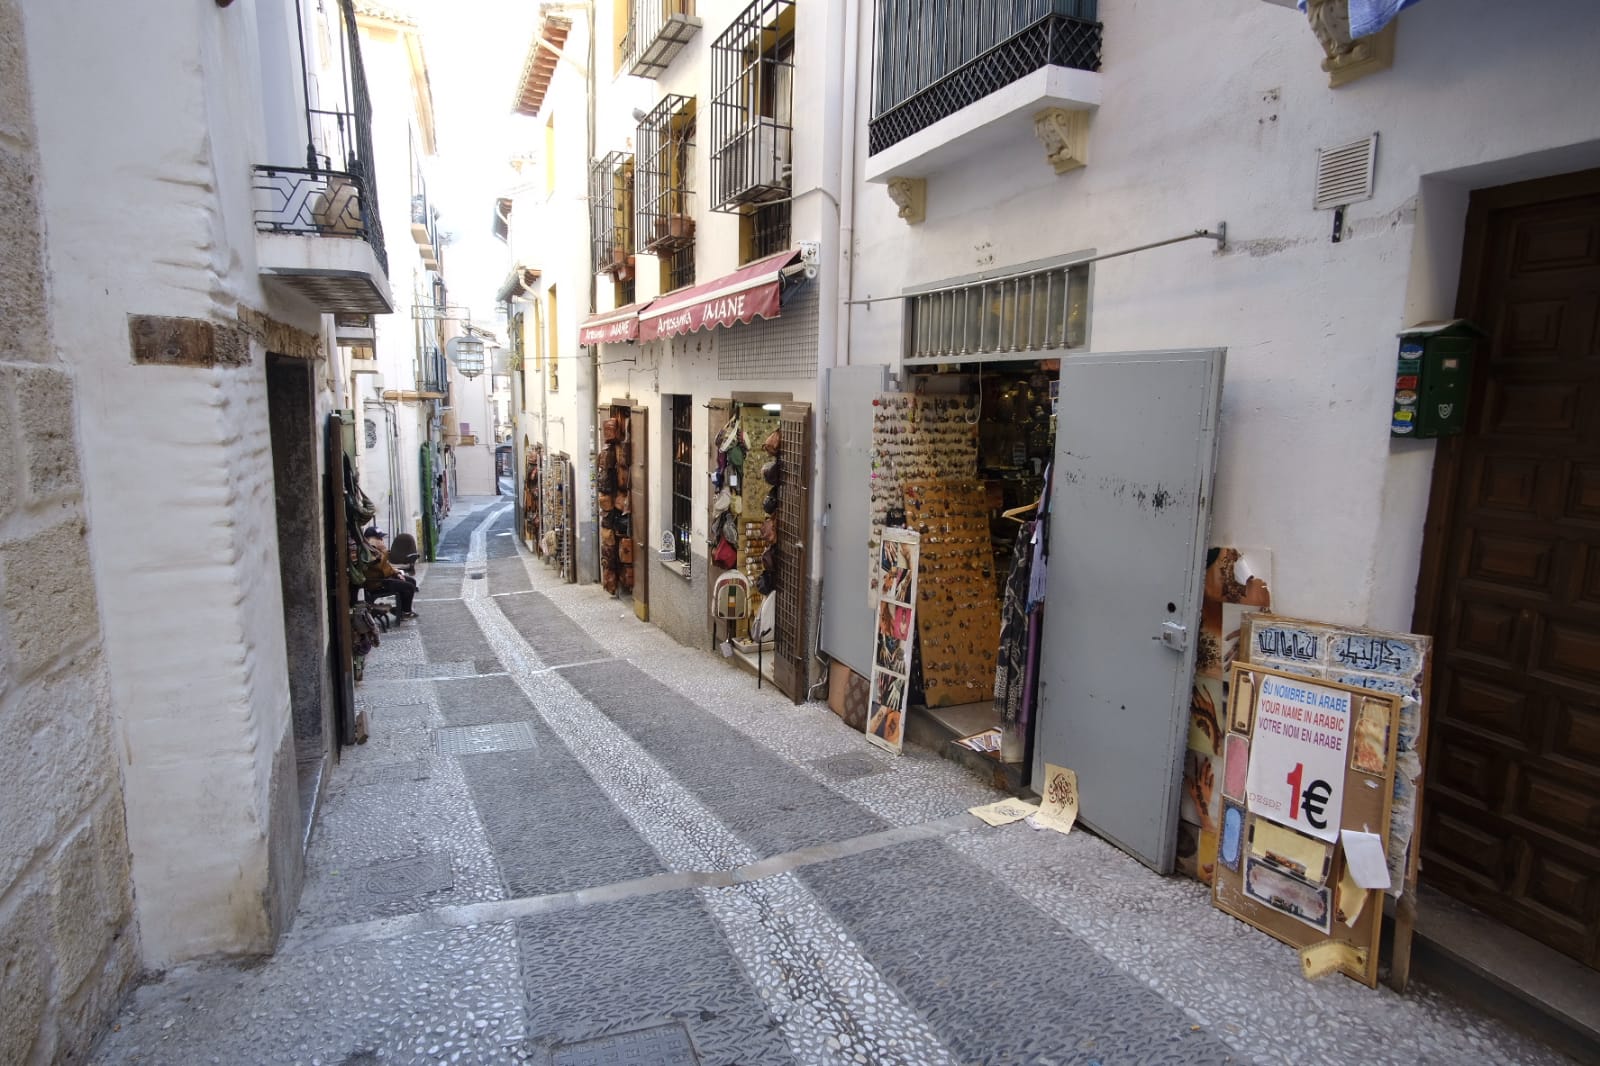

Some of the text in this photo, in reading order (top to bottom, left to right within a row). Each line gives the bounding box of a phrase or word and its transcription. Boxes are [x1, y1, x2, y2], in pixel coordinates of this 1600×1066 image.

[702, 295, 745, 321] IMANE
[1263, 681, 1348, 712] SU NOMBRE EN ARABE
[1261, 699, 1345, 732] YOUR NAME IN ARABIC
[1259, 717, 1342, 751] VOTRE NOM EN ARABE
